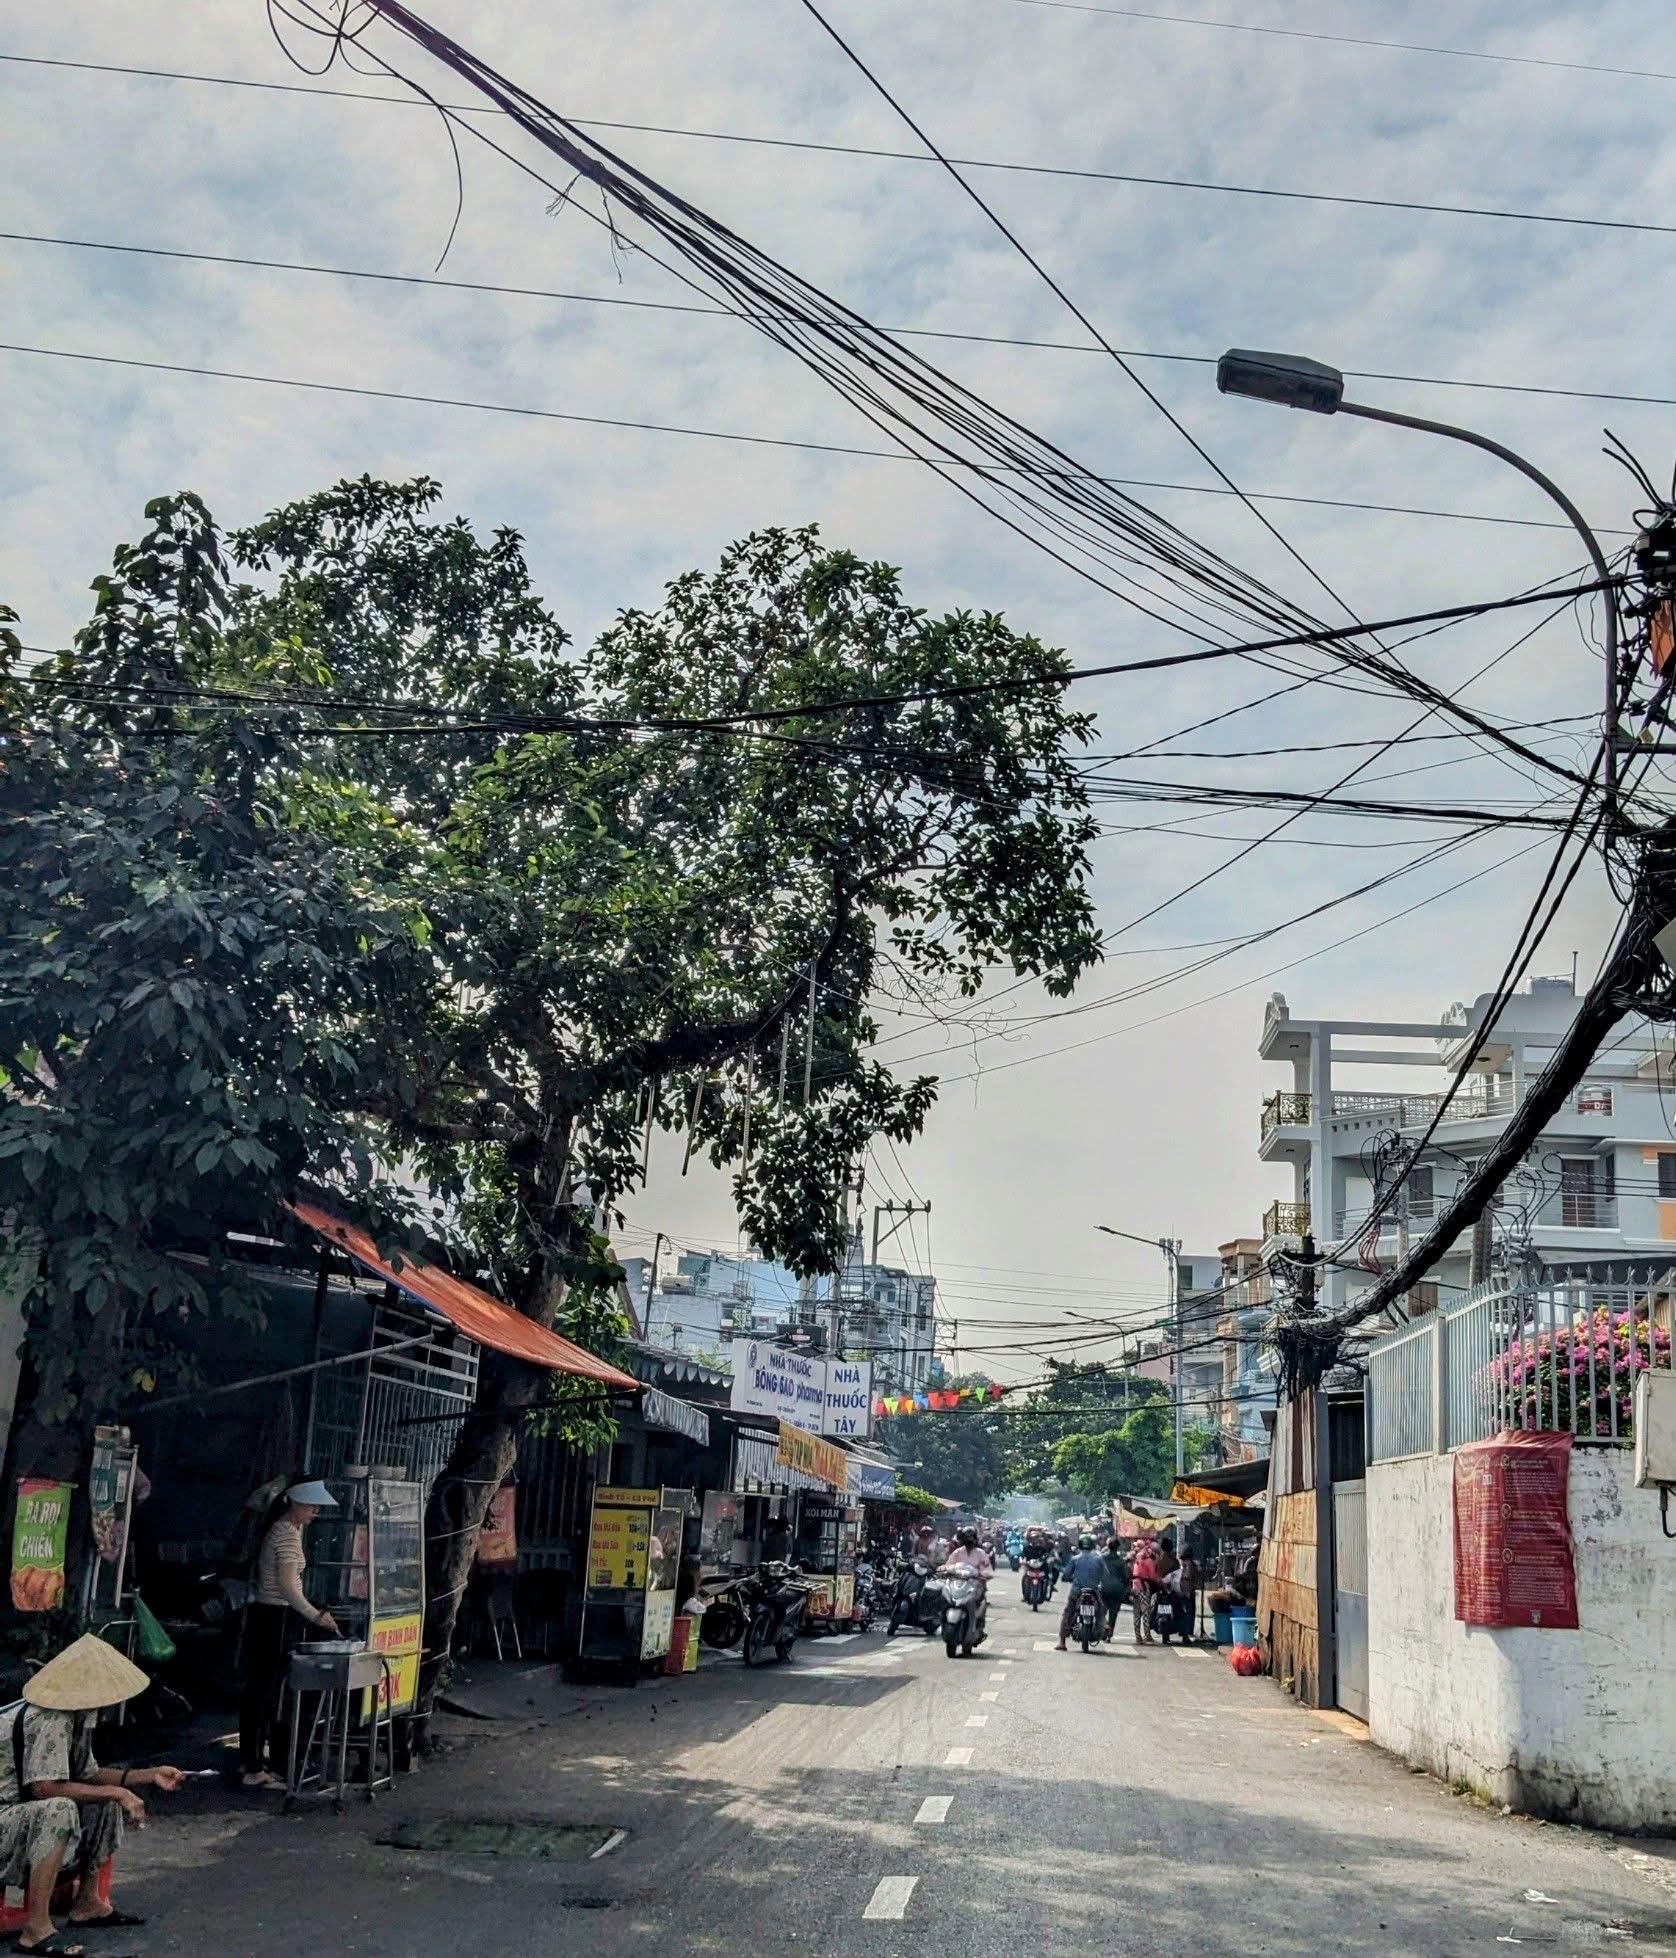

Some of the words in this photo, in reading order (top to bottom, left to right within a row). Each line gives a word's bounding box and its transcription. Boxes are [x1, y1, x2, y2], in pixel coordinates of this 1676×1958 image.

[769, 1351, 786, 1369] NHÀ
[788, 1357, 812, 1377] THUỐC
[834, 1365, 861, 1383] NHÀ
[779, 1376, 795, 1398] SAO
[796, 1382, 823, 1404] pharma
[827, 1388, 867, 1409] THUỐC
[834, 1415, 857, 1434] TÂY
[25, 1501, 40, 1524] BA
